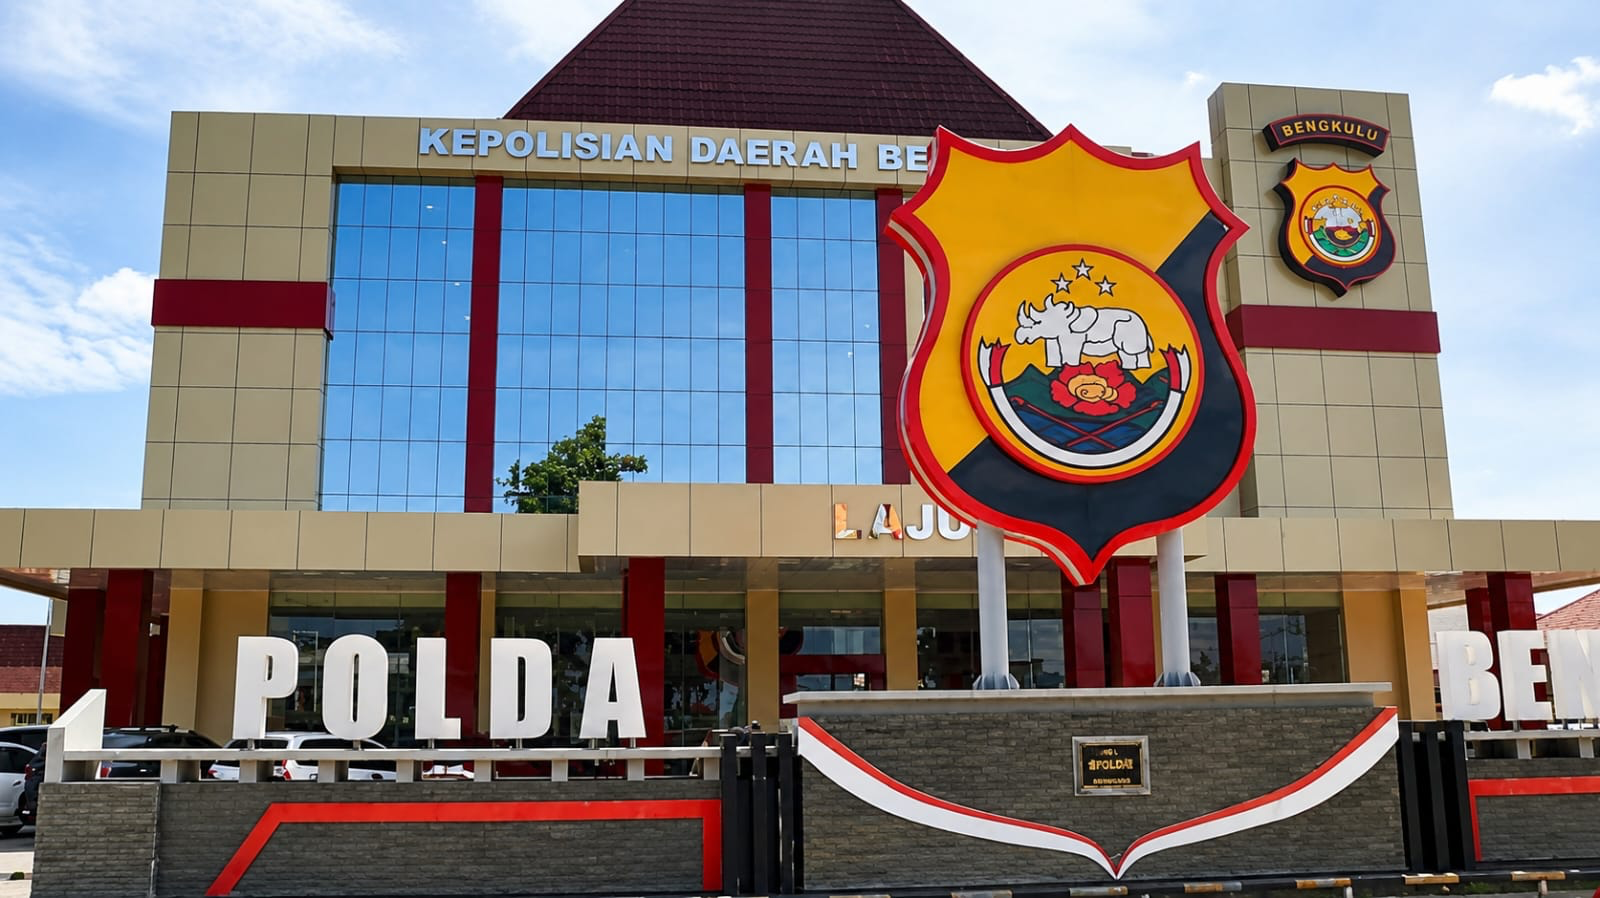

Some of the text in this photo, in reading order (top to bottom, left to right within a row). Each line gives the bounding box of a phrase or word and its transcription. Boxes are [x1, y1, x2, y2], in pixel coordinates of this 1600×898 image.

[419, 127, 929, 171] KEPOLISIAN DAERAH BE
[1281, 120, 1378, 141] BENGKULU
[233, 633, 647, 740] POLDA
